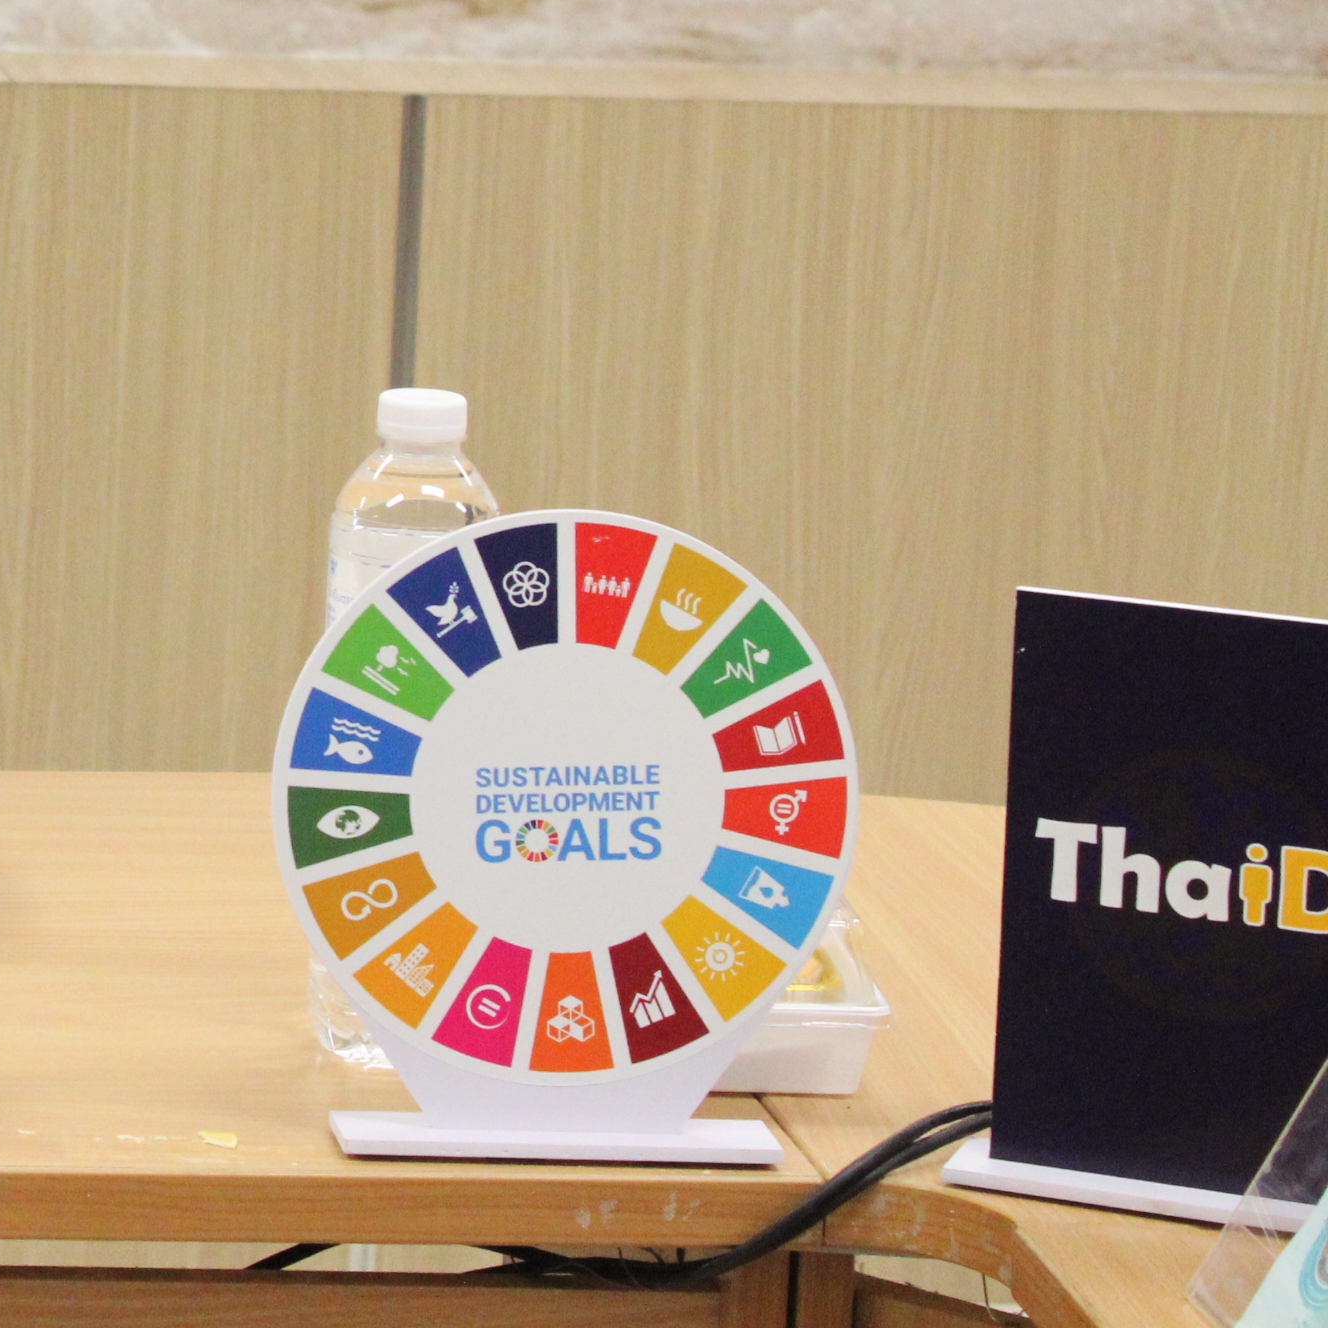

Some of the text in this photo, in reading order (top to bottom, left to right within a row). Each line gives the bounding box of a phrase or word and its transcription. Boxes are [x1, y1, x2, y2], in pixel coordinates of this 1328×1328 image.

[475, 763, 661, 789] SUSTAINABLE
[475, 790, 659, 814] DEVELOPMENT
[475, 816, 663, 864] GOALS
